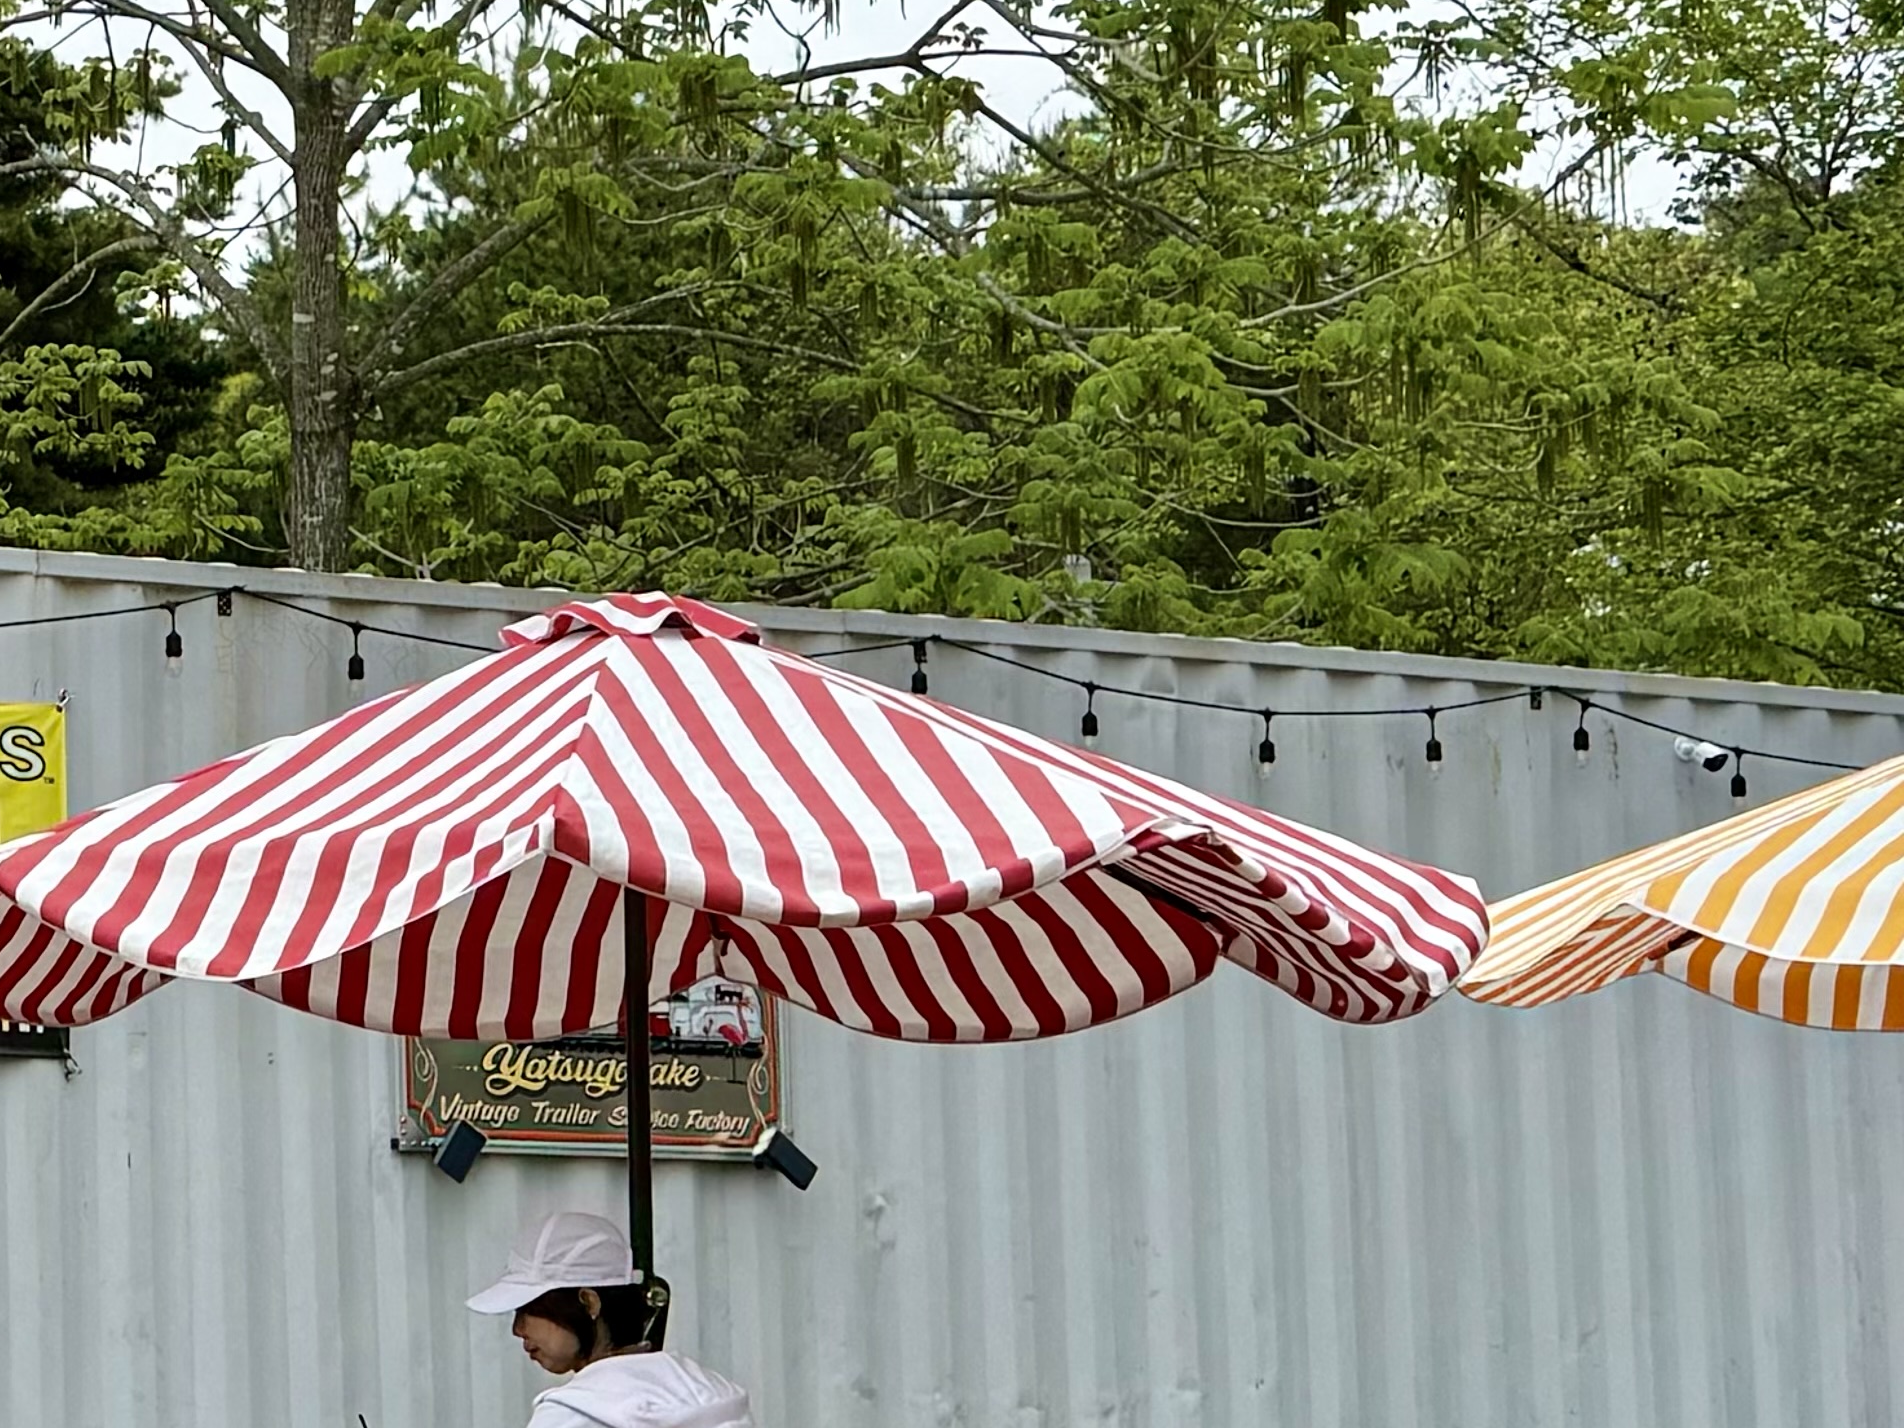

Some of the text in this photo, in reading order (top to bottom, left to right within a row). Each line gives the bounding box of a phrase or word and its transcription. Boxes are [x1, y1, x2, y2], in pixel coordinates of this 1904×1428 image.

[440, 1092, 519, 1127] Vintage
[531, 1101, 602, 1125] Trailer
[685, 1108, 749, 1136] Factory
